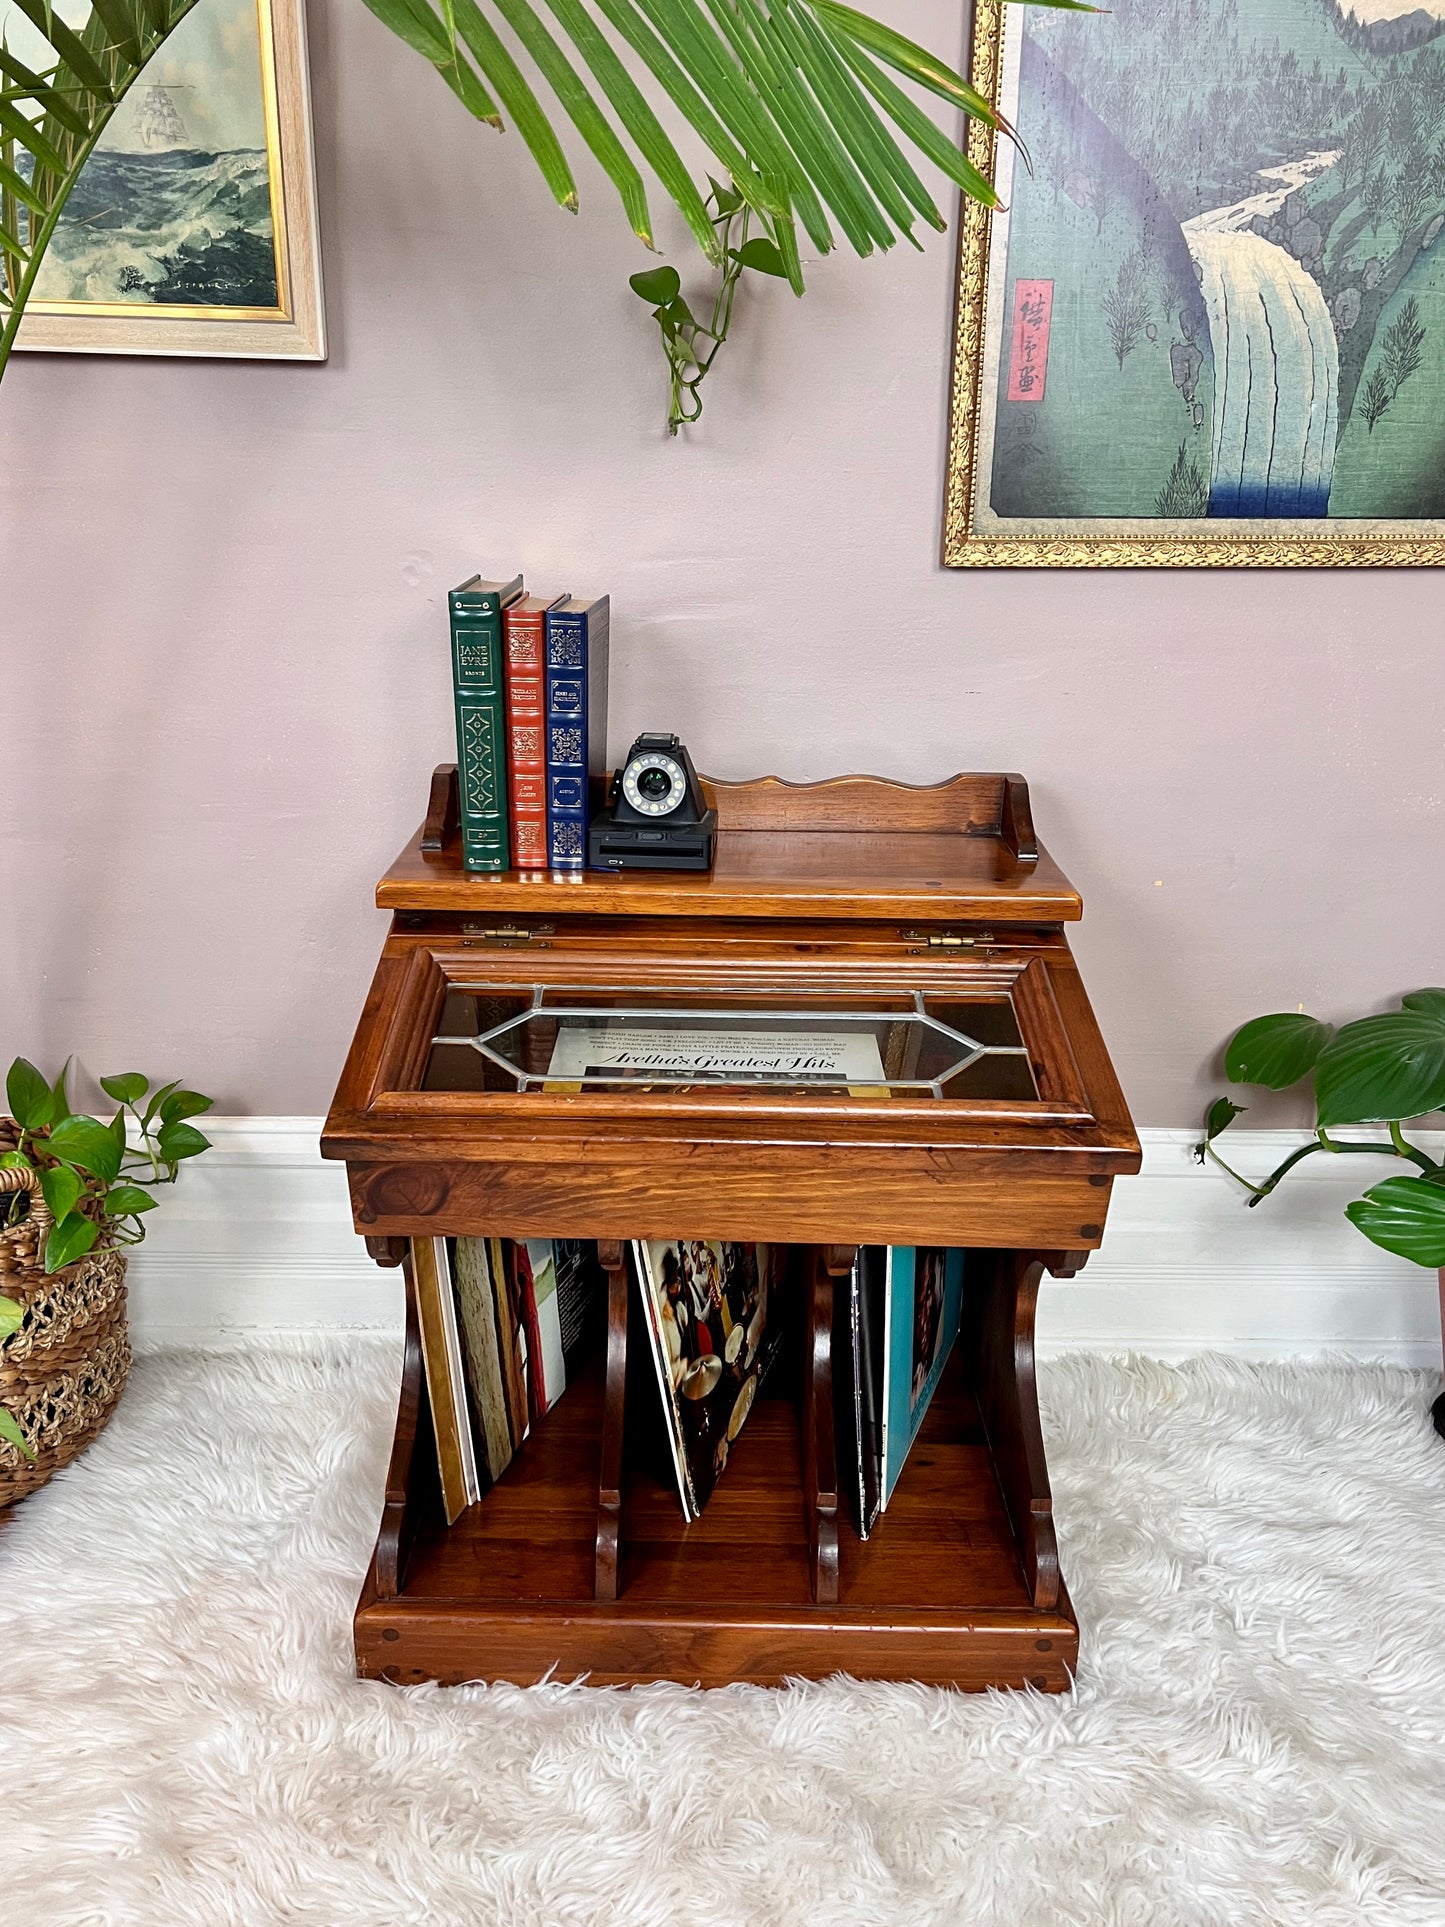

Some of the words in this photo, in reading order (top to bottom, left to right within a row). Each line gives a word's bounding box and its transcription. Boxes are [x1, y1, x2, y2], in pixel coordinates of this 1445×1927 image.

[460, 645, 488, 657] JANE
[461, 657, 489, 666] EYRE
[594, 1052, 691, 1066] Aretha's
[692, 1055, 782, 1070] Greatest
[785, 1055, 836, 1070] Hits
